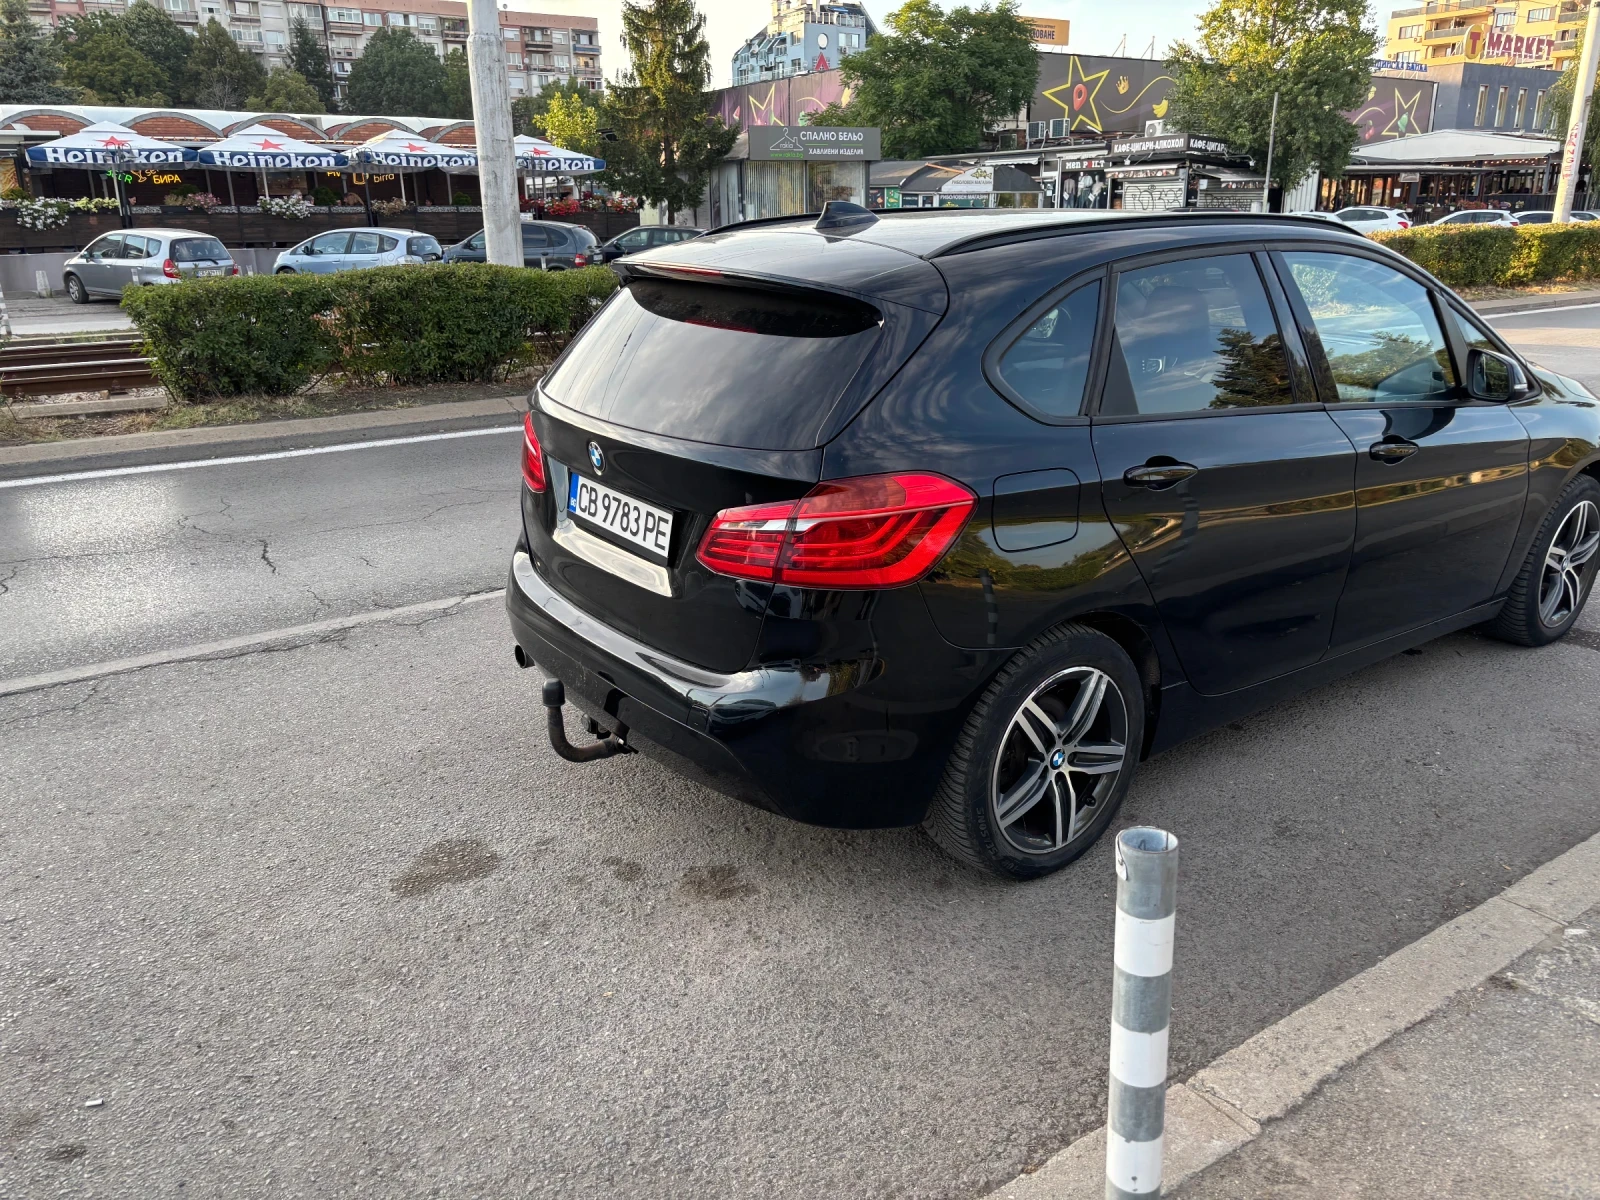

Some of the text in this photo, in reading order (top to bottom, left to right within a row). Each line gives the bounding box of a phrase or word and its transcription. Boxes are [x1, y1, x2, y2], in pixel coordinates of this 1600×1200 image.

[1032, 29, 1055, 40] ОВАНЕ
[1487, 32, 1555, 60] MARKET
[800, 131, 864, 141] СПАЛНО БЕЛЬО
[43, 147, 183, 163] Heineken
[211, 150, 336, 167] Heineken
[371, 152, 477, 167] Heineken
[515, 157, 595, 171] eineken
[153, 174, 181, 184] БИРА
[373, 173, 395, 183] birra
[578, 483, 670, 551] CB 9783 PE
